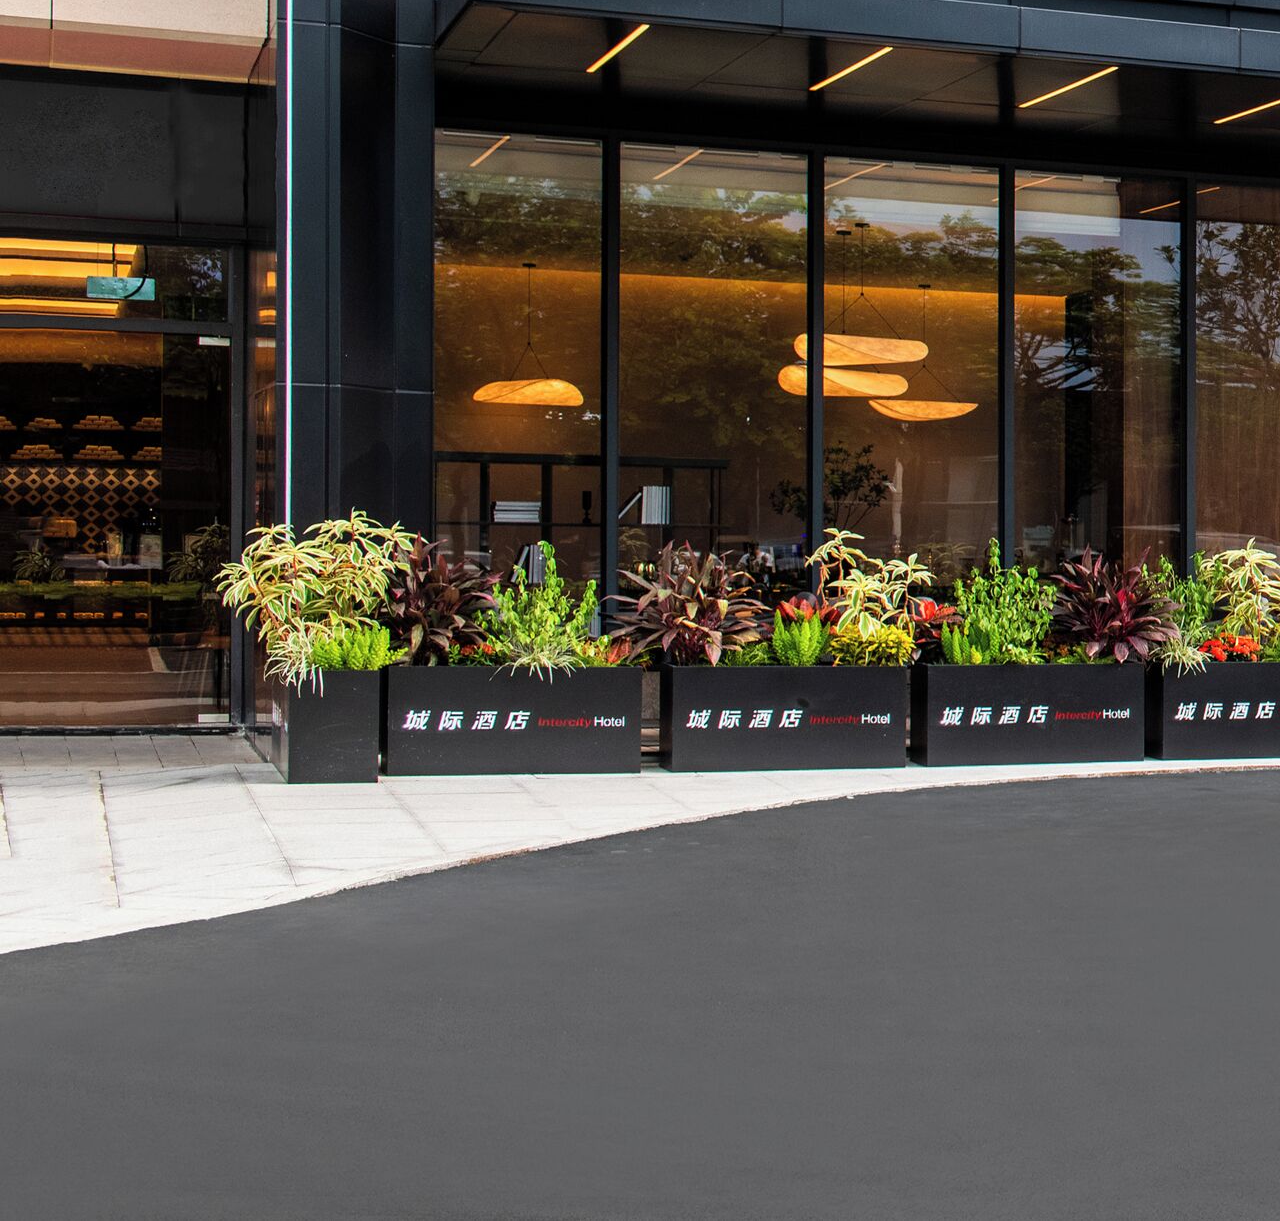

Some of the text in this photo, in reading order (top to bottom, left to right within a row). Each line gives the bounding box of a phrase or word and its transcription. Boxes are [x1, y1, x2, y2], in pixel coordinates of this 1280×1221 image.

[402, 709, 531, 731] 城际酒店
[594, 715, 625, 727] Hotel
[685, 708, 804, 730] 城际酒店
[861, 713, 891, 725] Hotel
[939, 705, 1049, 726] 城际酒店
[1102, 707, 1130, 719] Hotel
[1174, 701, 1276, 721] 城际酒店
